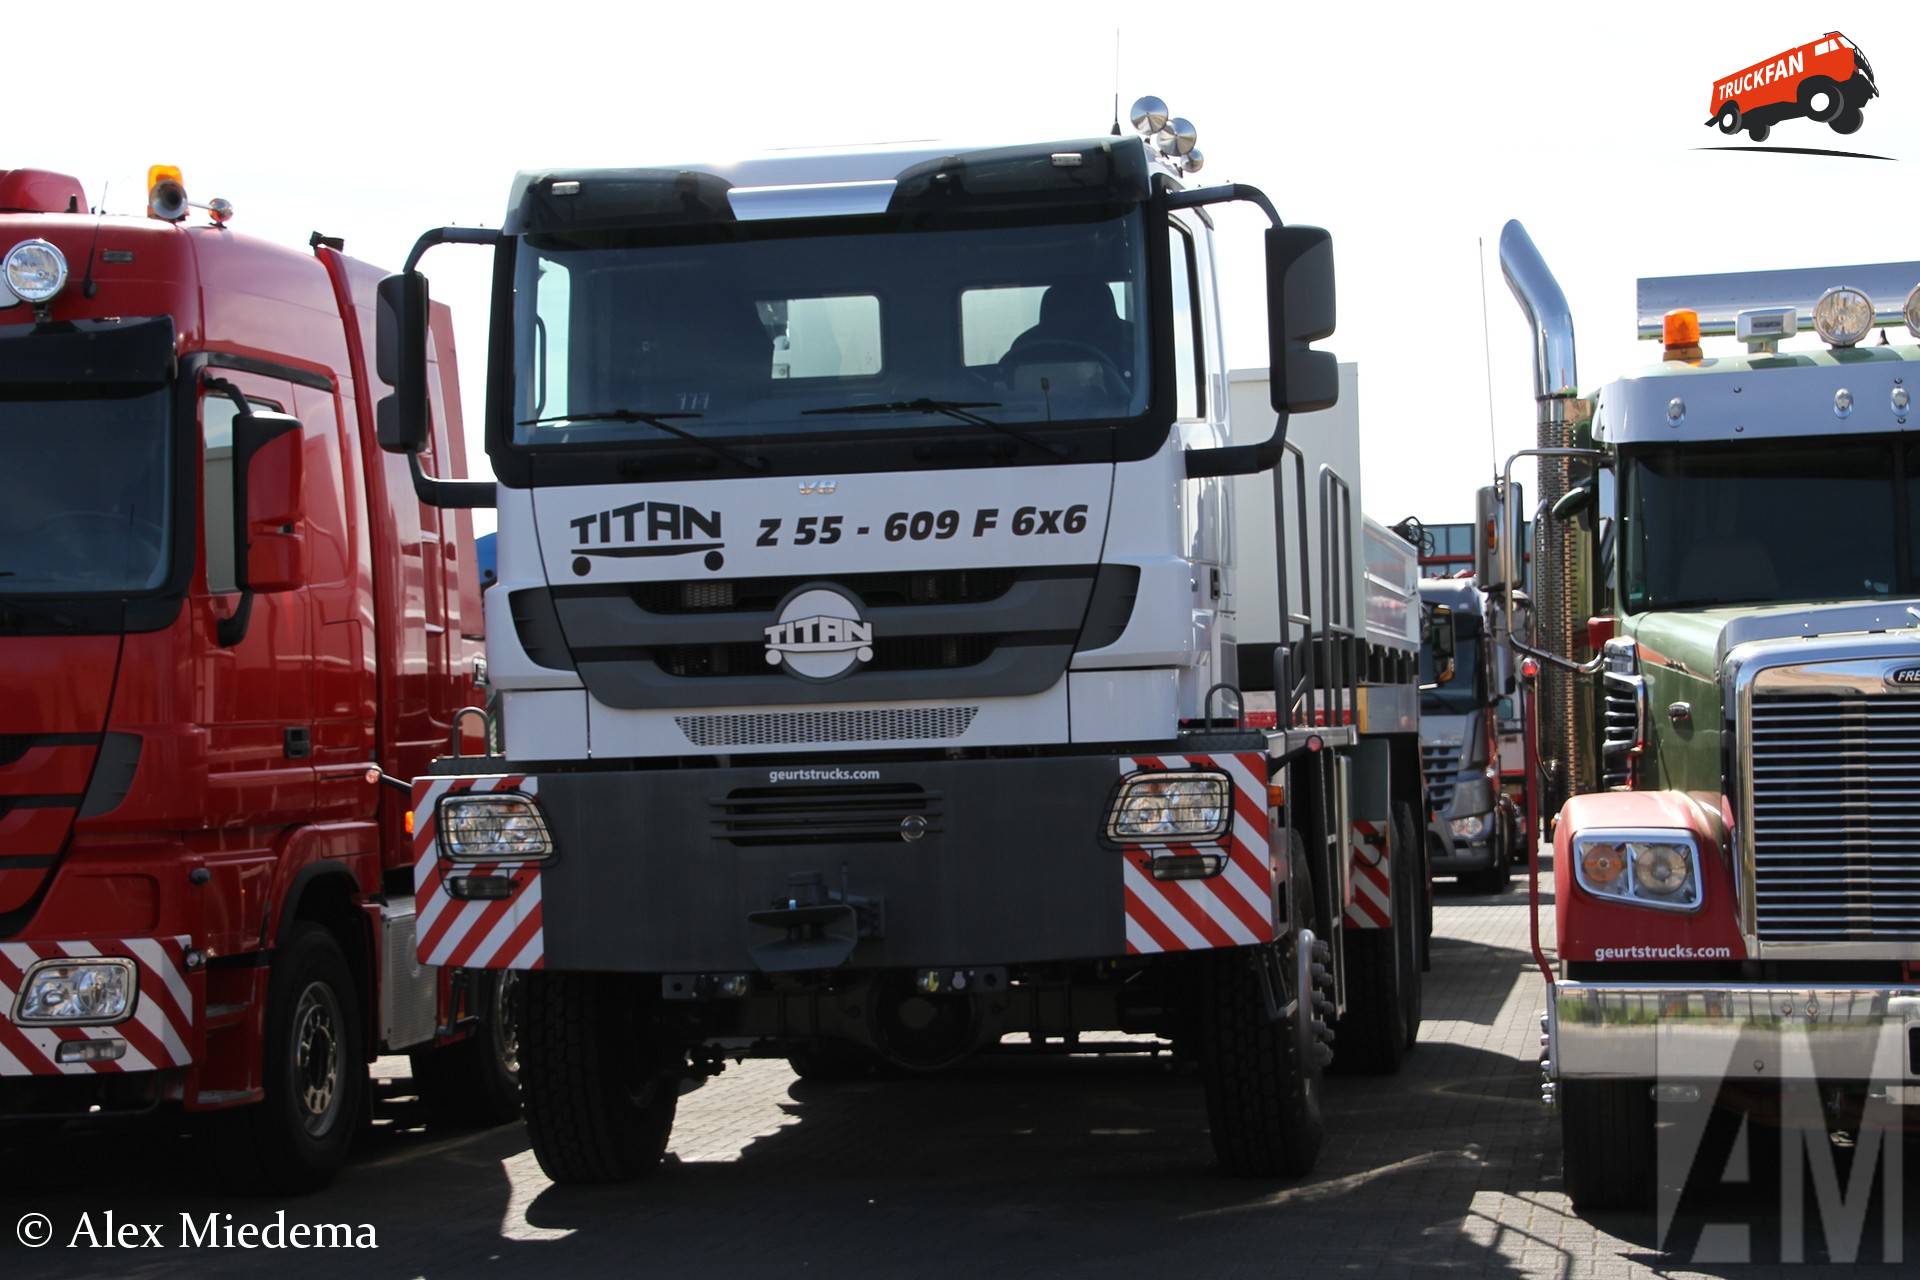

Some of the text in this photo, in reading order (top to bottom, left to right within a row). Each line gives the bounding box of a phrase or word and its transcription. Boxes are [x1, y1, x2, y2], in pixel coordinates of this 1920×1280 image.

[570, 501, 722, 545] TITAN
[756, 518, 782, 547] Z
[793, 516, 844, 545] 55
[884, 510, 960, 541] 609
[972, 508, 999, 537] F
[1011, 504, 1089, 536] 6x6
[764, 616, 872, 645] TITAN
[769, 768, 880, 782] geurtstrucks.com
[1594, 944, 1730, 962] geurtstrucks.com
